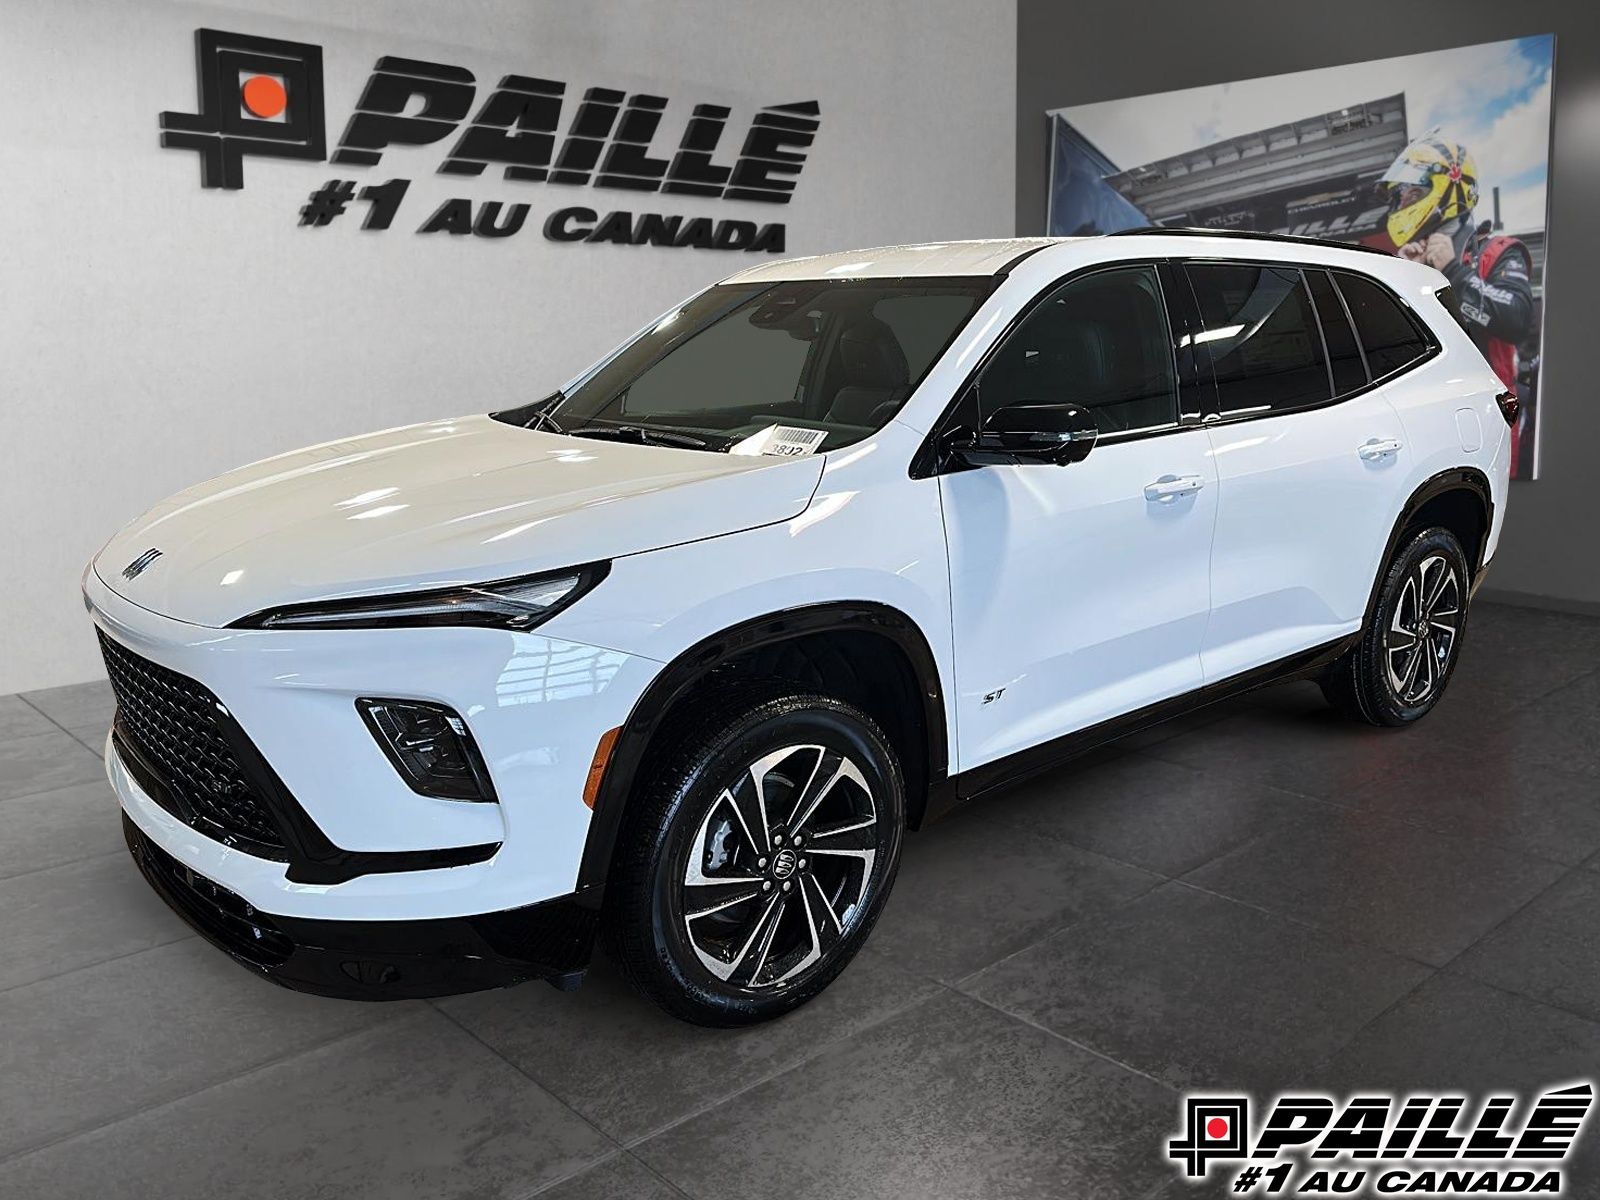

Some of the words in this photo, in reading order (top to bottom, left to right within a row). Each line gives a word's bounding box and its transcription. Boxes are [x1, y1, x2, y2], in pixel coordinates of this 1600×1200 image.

[329, 55, 821, 204] PAILLÉ
[297, 179, 411, 230] #1
[415, 198, 531, 238] AU
[543, 206, 787, 253] CANADA
[981, 687, 1006, 704] ST
